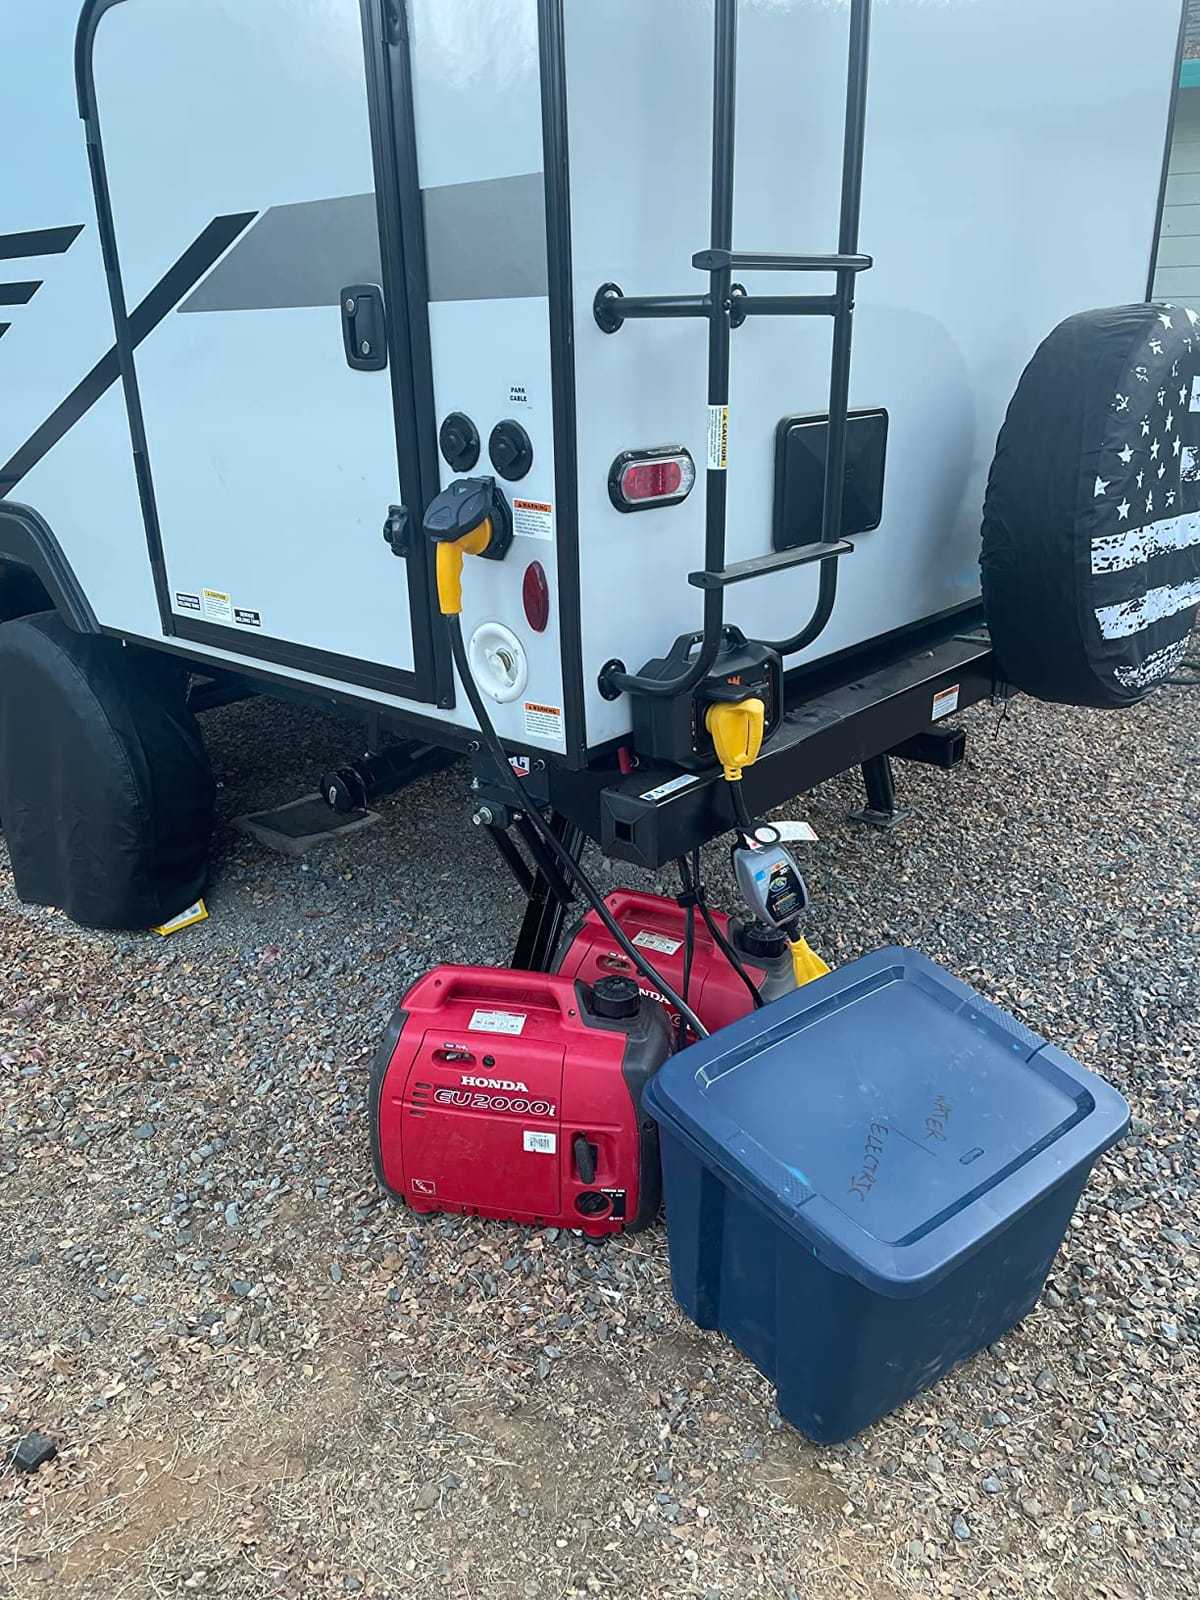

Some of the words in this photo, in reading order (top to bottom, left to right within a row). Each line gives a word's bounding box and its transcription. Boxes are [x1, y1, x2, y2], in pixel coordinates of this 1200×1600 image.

[510, 386, 526, 394] PARK
[532, 704, 558, 715] WARNING
[638, 987, 672, 1005] NDA
[461, 1075, 529, 1093] HONDA
[433, 1088, 556, 1117] EU2000i
[923, 1095, 952, 1141] WATER
[847, 1122, 889, 1202] ELECTRIC
